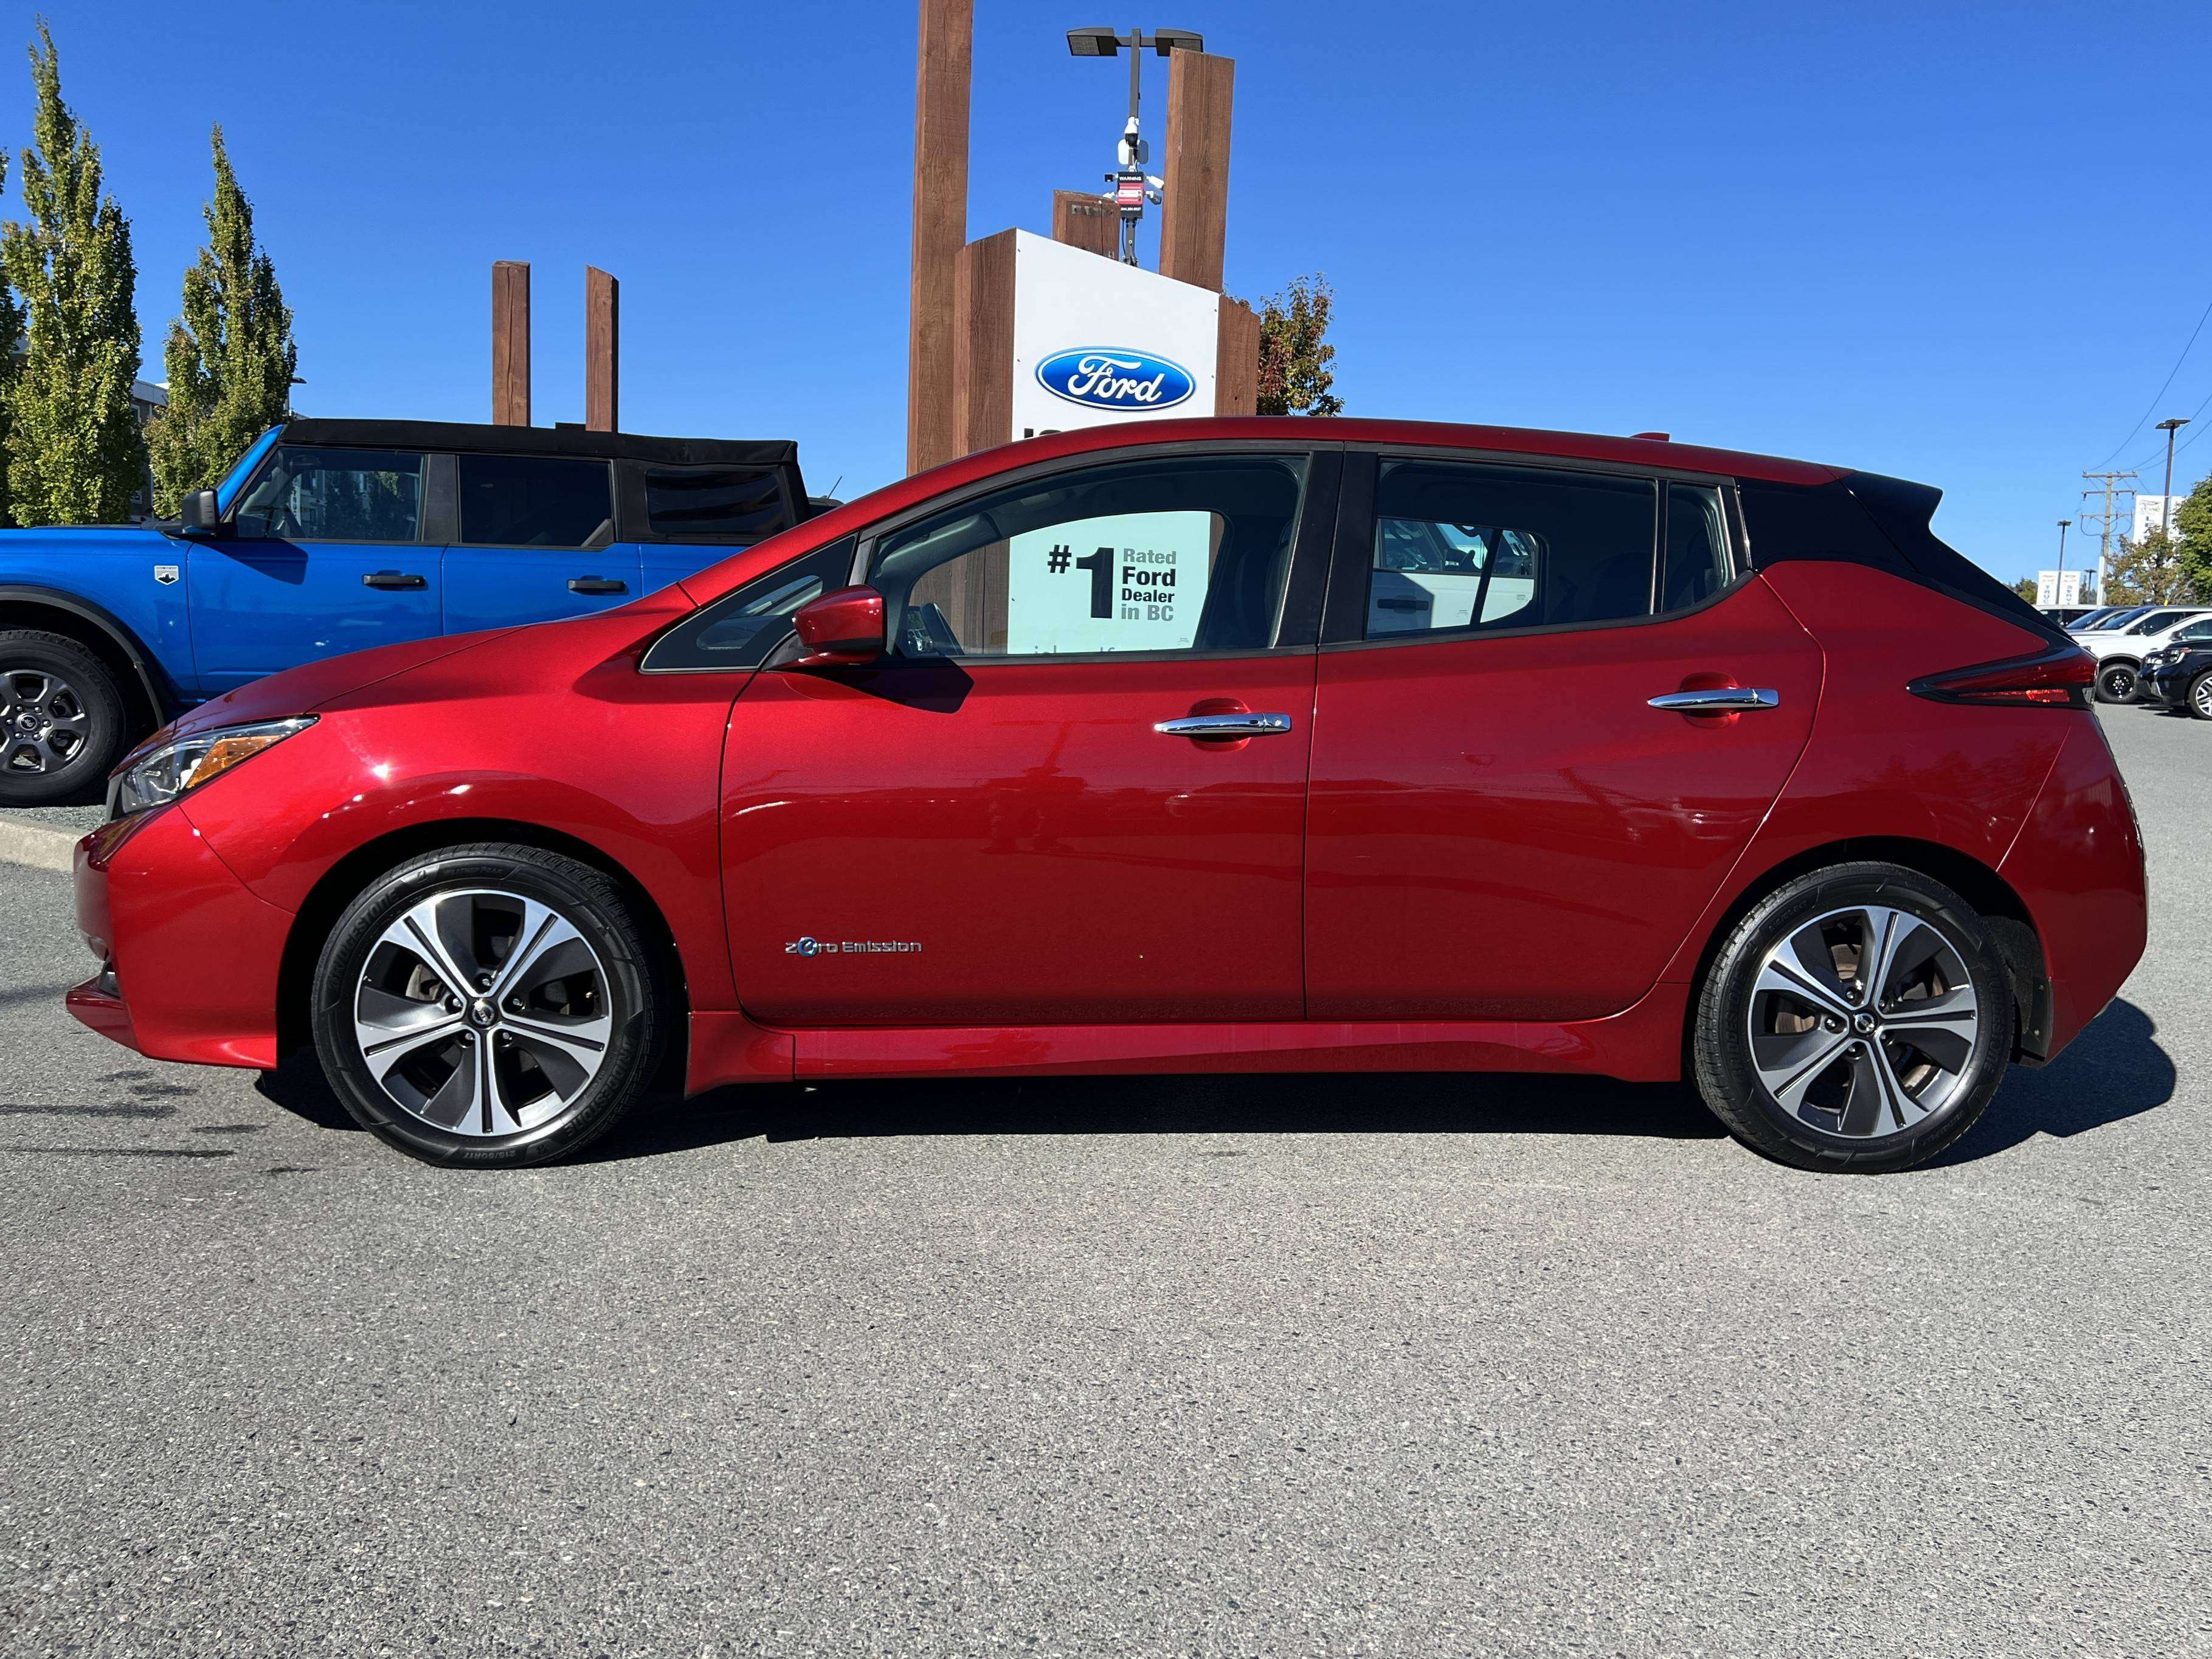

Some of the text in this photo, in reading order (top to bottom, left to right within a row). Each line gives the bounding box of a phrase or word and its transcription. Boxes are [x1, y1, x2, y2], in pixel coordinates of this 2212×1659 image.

[1068, 355, 1166, 402] Ford
[1123, 548, 1177, 564] Rated
[1047, 544, 1115, 619] #1
[1122, 566, 1176, 586] Ford
[1121, 587, 1175, 603] Dealer
[1121, 604, 1174, 621] in BC
[842, 940, 923, 954] Emission
